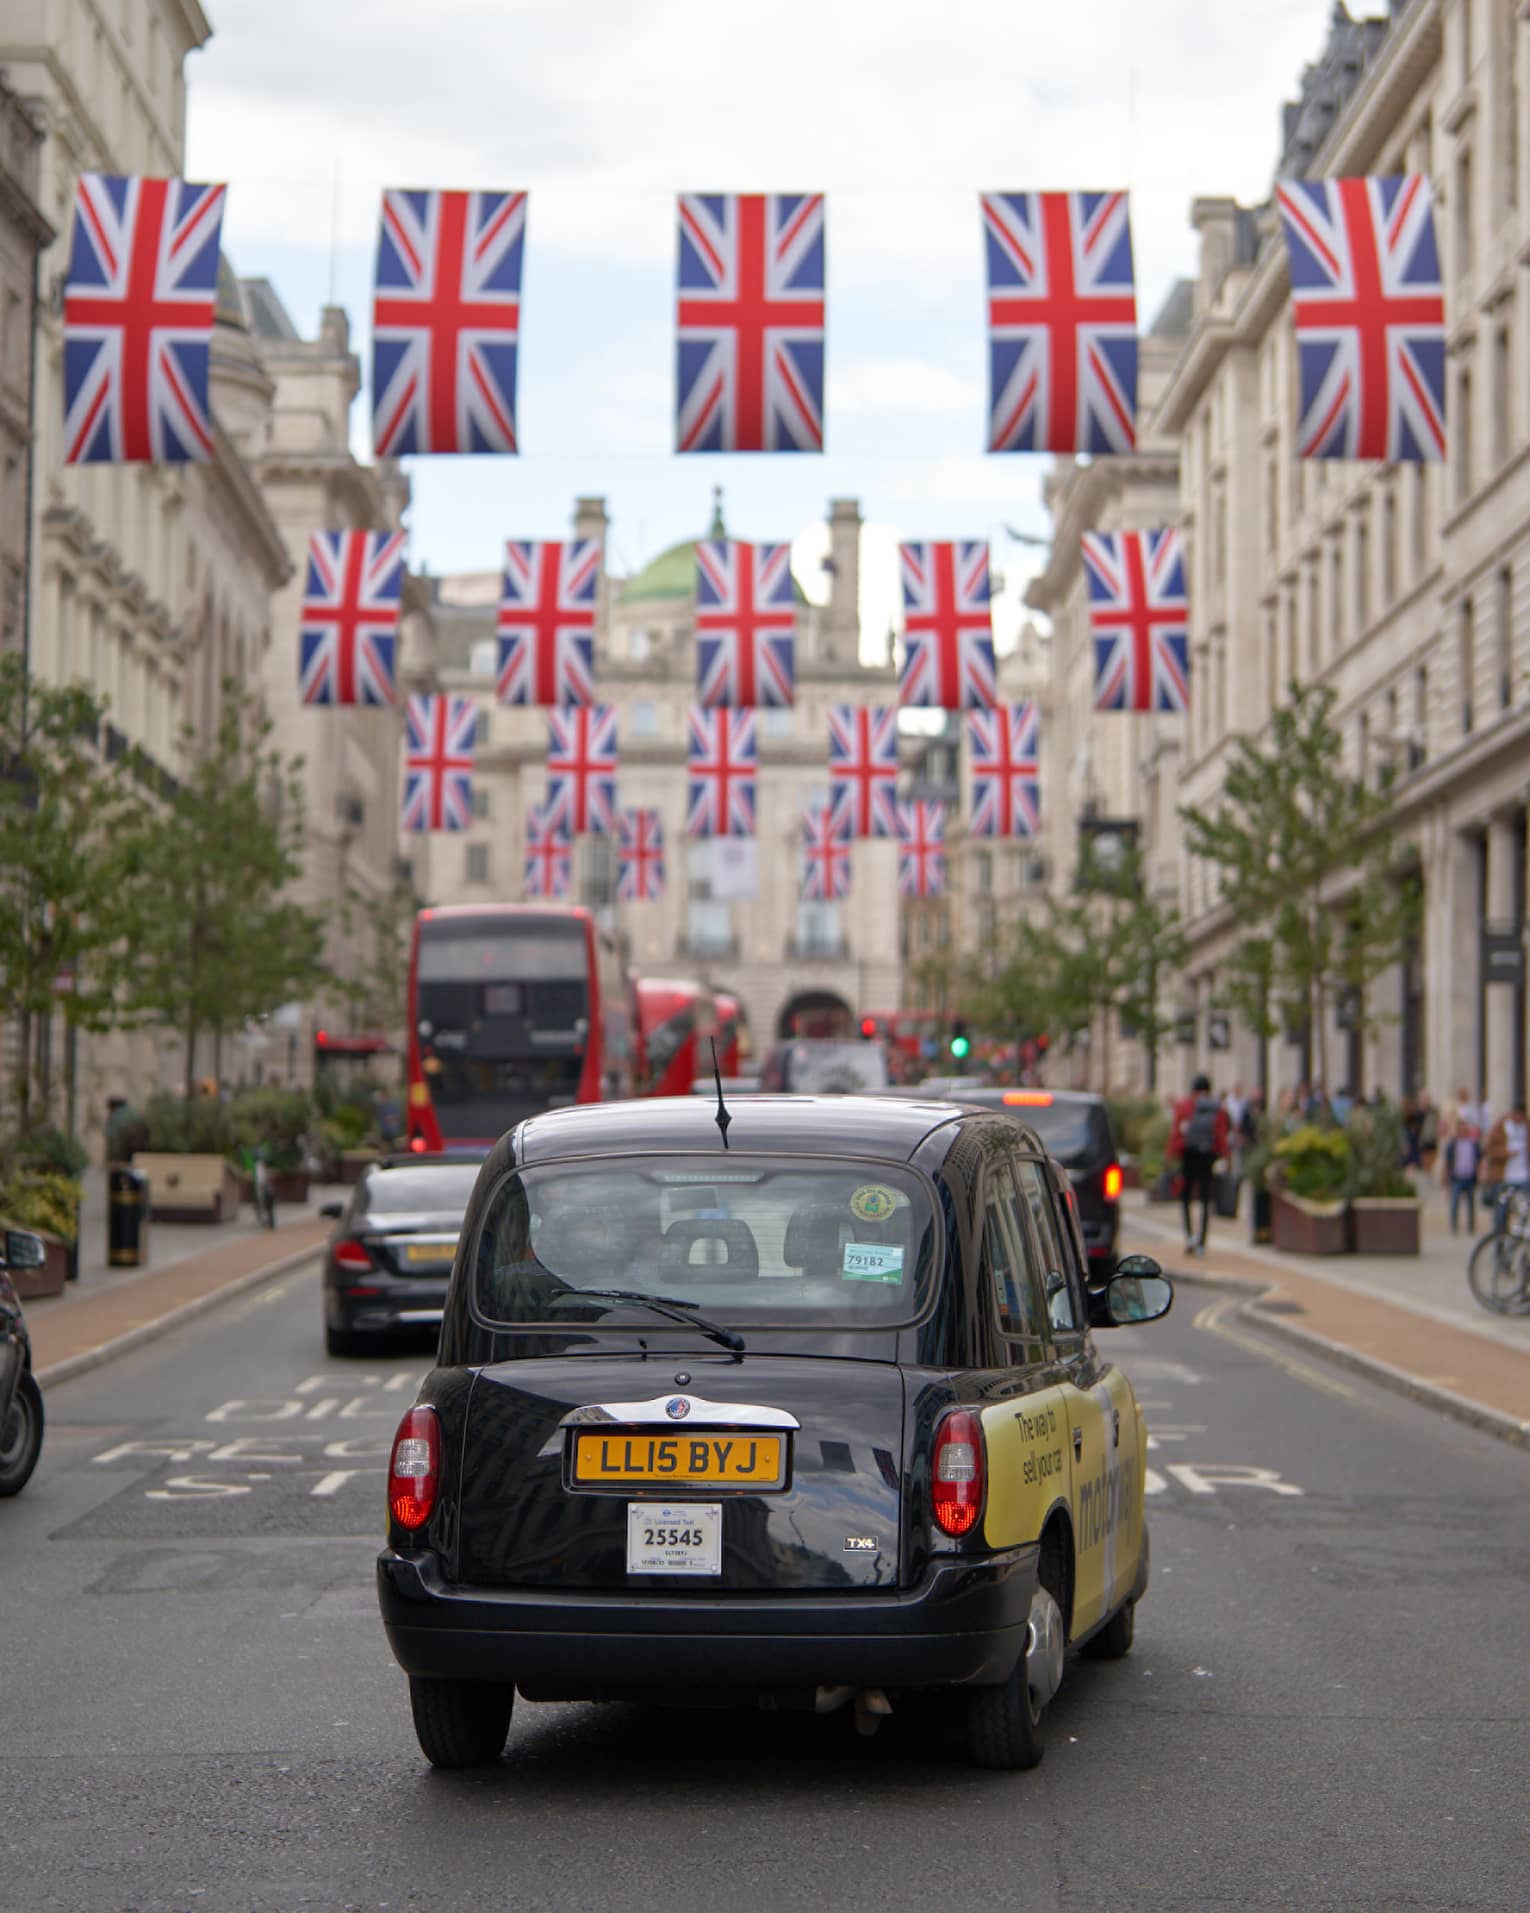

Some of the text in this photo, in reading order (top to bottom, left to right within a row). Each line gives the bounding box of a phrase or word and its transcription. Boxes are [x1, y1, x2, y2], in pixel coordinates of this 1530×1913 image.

[1014, 1412, 1034, 1443] The
[601, 1440, 757, 1473] LL15 BYJ
[644, 1528, 703, 1547] 25545
[847, 1537, 875, 1549] TX4
